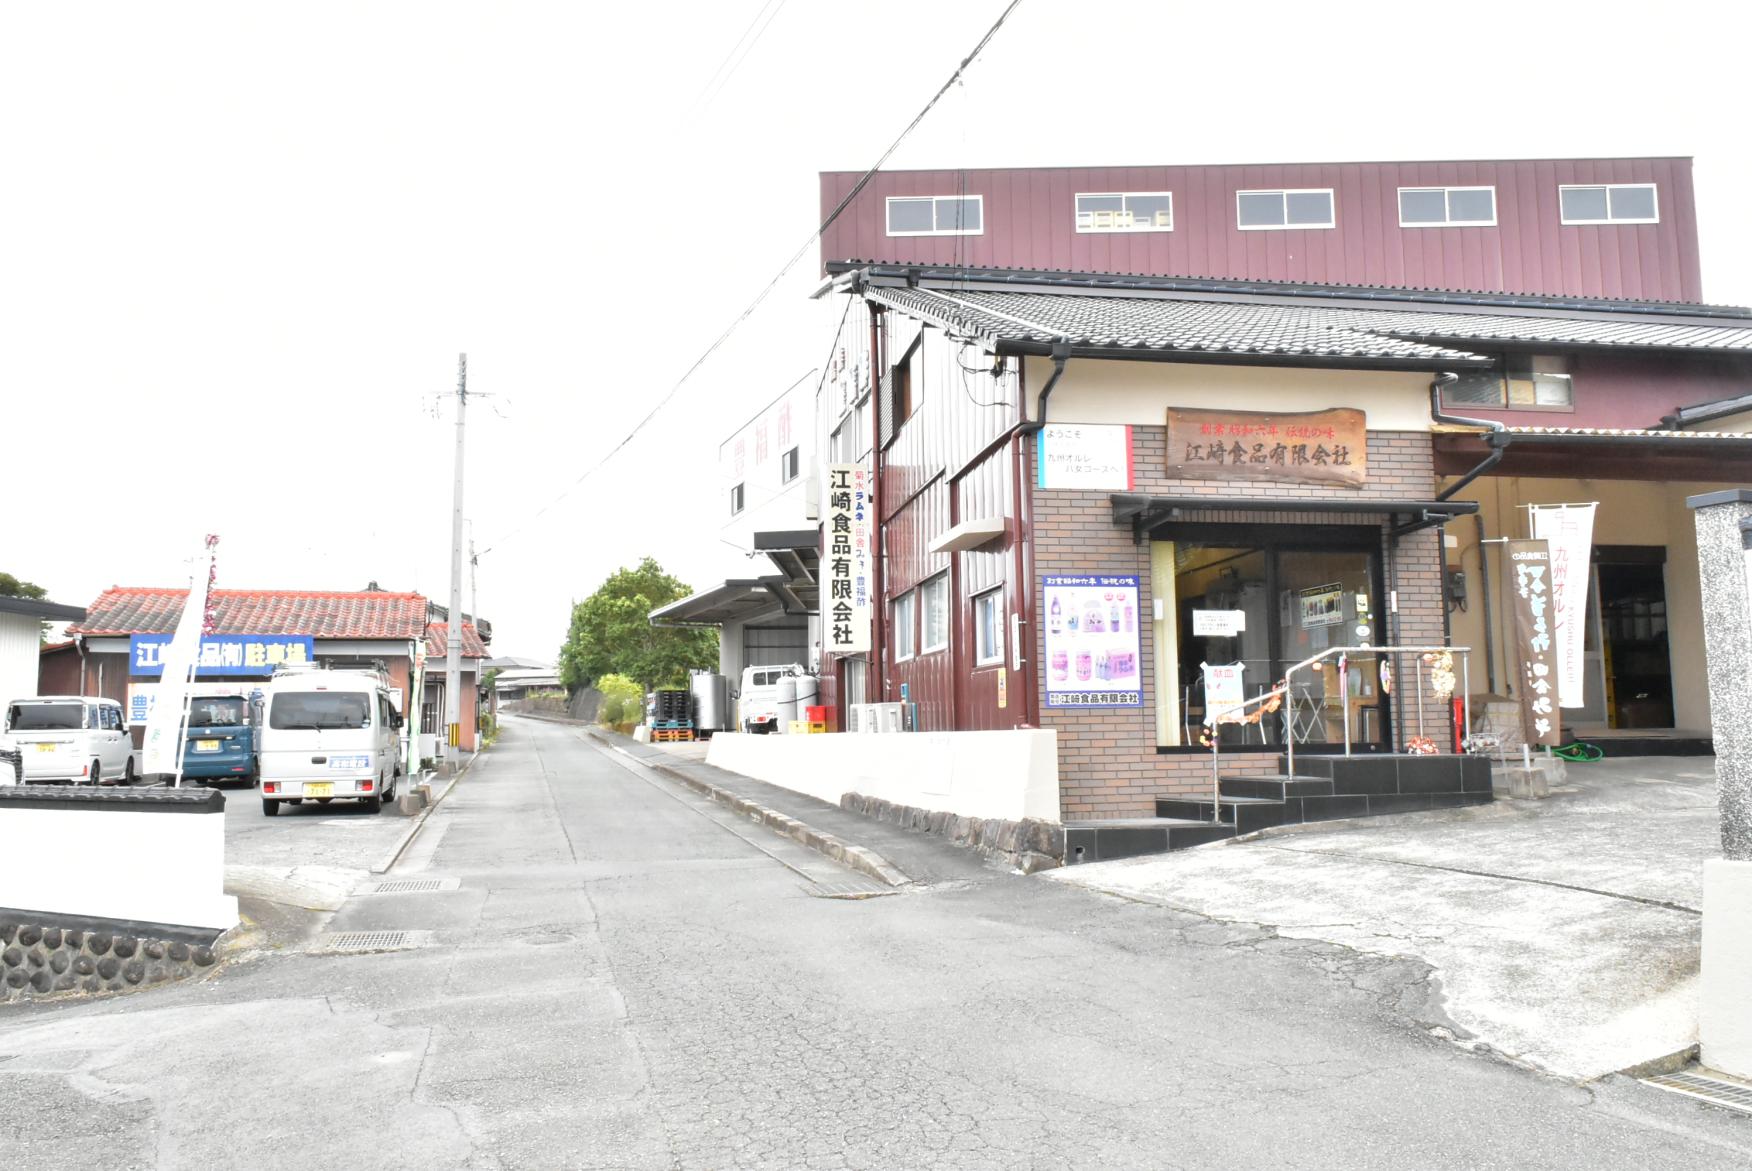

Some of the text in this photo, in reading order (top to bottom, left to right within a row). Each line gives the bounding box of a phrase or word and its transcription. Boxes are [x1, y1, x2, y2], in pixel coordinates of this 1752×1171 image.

[1046, 429, 1081, 439] ようこそ
[1048, 454, 1093, 464] 九州オルレ
[830, 469, 854, 646] 江崎食品有限会社
